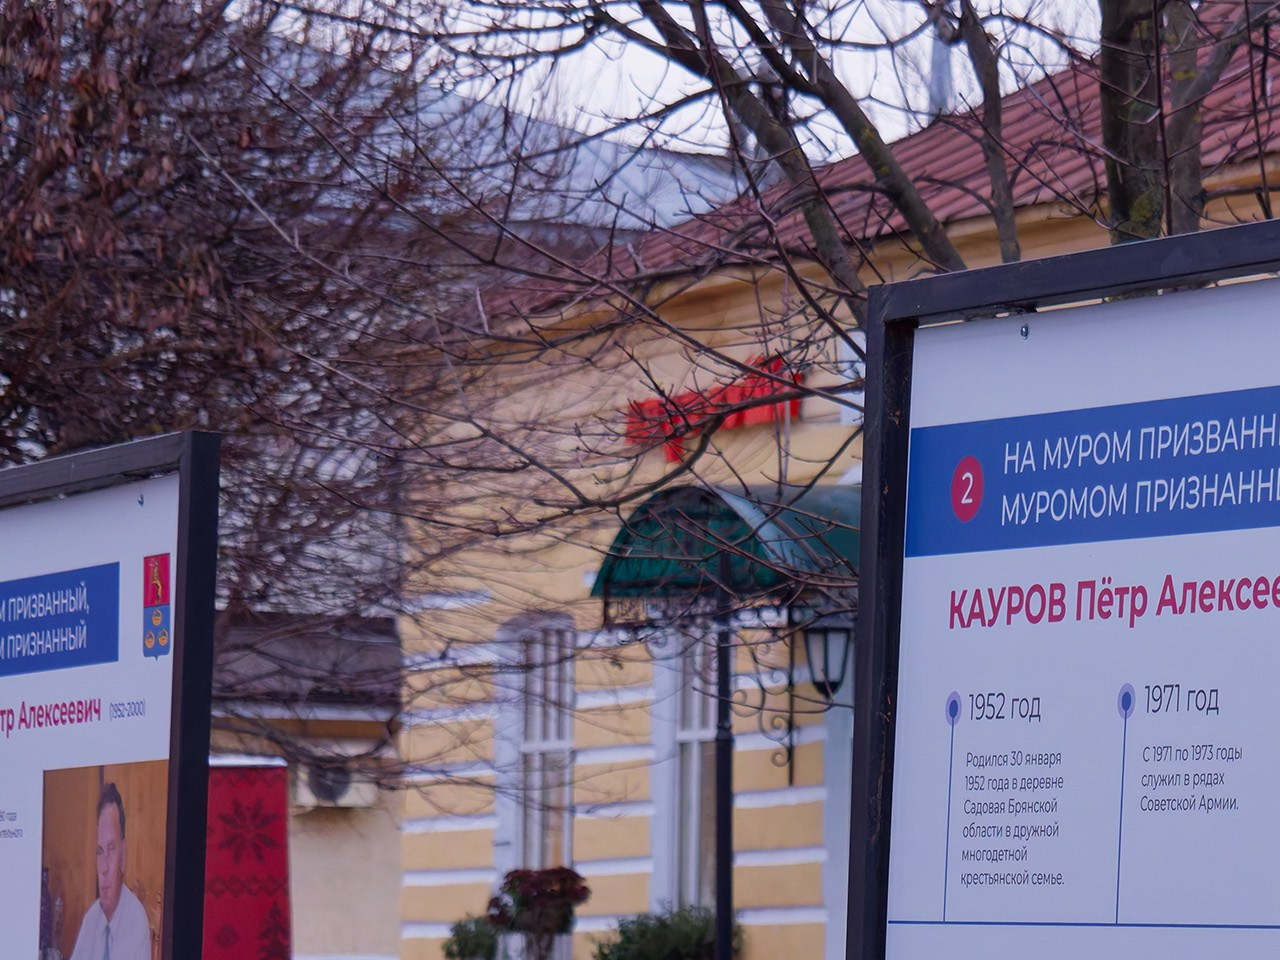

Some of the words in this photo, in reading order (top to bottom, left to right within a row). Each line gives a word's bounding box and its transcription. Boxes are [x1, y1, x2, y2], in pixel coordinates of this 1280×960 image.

[1004, 441, 1036, 474] НА
[1042, 429, 1130, 471] МУРОМ
[961, 473, 973, 504] 2
[1002, 483, 1130, 526] МУРОМОМ
[8, 581, 89, 621] ПРИЗВАННЫЙ,
[950, 583, 1066, 629] КАУРОВ
[1076, 577, 1147, 628] Пётр
[7, 619, 87, 659] ПРИЗНАННЫЙ
[969, 693, 1005, 721] 1952
[1011, 696, 1041, 723] год
[1145, 684, 1180, 713] 1971
[1187, 689, 1219, 715] год
[0, 707, 14, 738] тр
[18, 698, 101, 730] Алексеевич
[966, 752, 1008, 769] Родился
[1010, 751, 1023, 766] 30
[1025, 752, 1062, 769] января
[1142, 746, 1150, 762] С
[1153, 746, 1172, 762] 1971
[1175, 748, 1188, 761] по
[1191, 744, 1214, 760] 1973
[1216, 747, 1243, 763] годы
[965, 775, 985, 791] 1952
[987, 778, 1009, 792] года
[1012, 778, 1018, 790] в
[1019, 776, 1064, 792] деревне
[1141, 773, 1181, 790] служил
[1184, 774, 1190, 786] в
[1193, 773, 1225, 789] рядах
[963, 800, 1006, 816] Садовая
[1008, 798, 1058, 817] Брянской
[1140, 795, 1196, 812] Советской
[1199, 795, 1239, 813] Армии.
[963, 822, 1003, 838] области
[1005, 825, 1011, 838] в
[1013, 821, 1059, 841] дружной
[961, 846, 1028, 863] многодетной
[960, 870, 1029, 888] крестьянской
[1031, 873, 1065, 886] семье.
